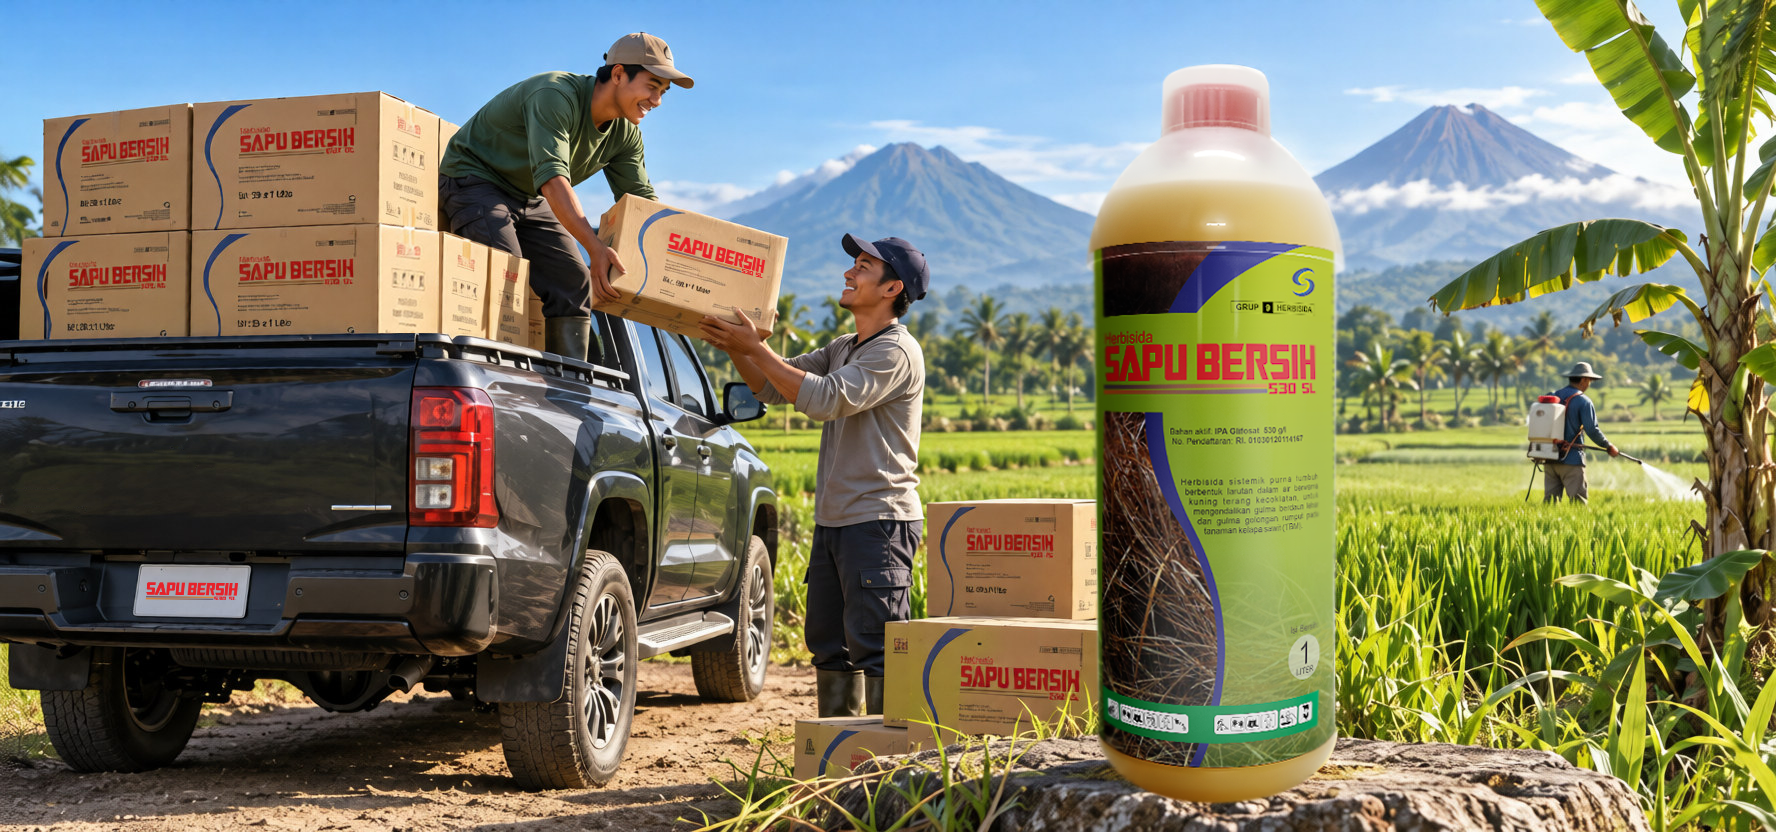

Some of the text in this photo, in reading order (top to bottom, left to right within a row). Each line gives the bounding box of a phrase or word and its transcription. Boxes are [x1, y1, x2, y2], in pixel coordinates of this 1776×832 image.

[239, 127, 354, 153] SAPU BERSIH
[81, 137, 169, 163] SAPU BERSIH
[668, 232, 714, 260] SAPU
[715, 246, 765, 273] BERSIH
[68, 263, 167, 287] SAPU BERSIH
[239, 258, 354, 281] SAPU BERSIH
[1235, 302, 1259, 311] GRUP
[1276, 304, 1312, 313] HERBISIDA
[1105, 331, 1153, 345] Herbisida
[1105, 343, 1316, 382] SAPU BERSIH
[1268, 383, 1316, 394] 530 SL
[1169, 427, 1193, 435] Bahan
[1214, 427, 1228, 435] IPA
[1263, 426, 1277, 434] 530
[1171, 437, 1184, 446] No.
[1180, 478, 1223, 486] Herbisida
[1228, 477, 1265, 485] sistemik
[1269, 476, 1292, 485] purna
[1184, 488, 1223, 496] berbentuk
[1226, 487, 1253, 495] larutan
[1256, 485, 1279, 494] dalam
[1188, 499, 1218, 507] kuning
[1222, 497, 1251, 506] terang
[1192, 508, 1251, 517] mengendalikan
[1253, 506, 1276, 515] gulma
[1215, 517, 1241, 526] gulma
[1244, 515, 1279, 525] golongan
[1203, 526, 1237, 535] tanaman
[1238, 524, 1263, 534] kelapa
[966, 535, 1054, 551] SAPU BERSIH
[145, 582, 239, 596] SAPU BERSIH
[1300, 640, 1308, 665] 1
[1296, 664, 1314, 677] LITER
[960, 665, 1080, 692] SAPU BERSIH
